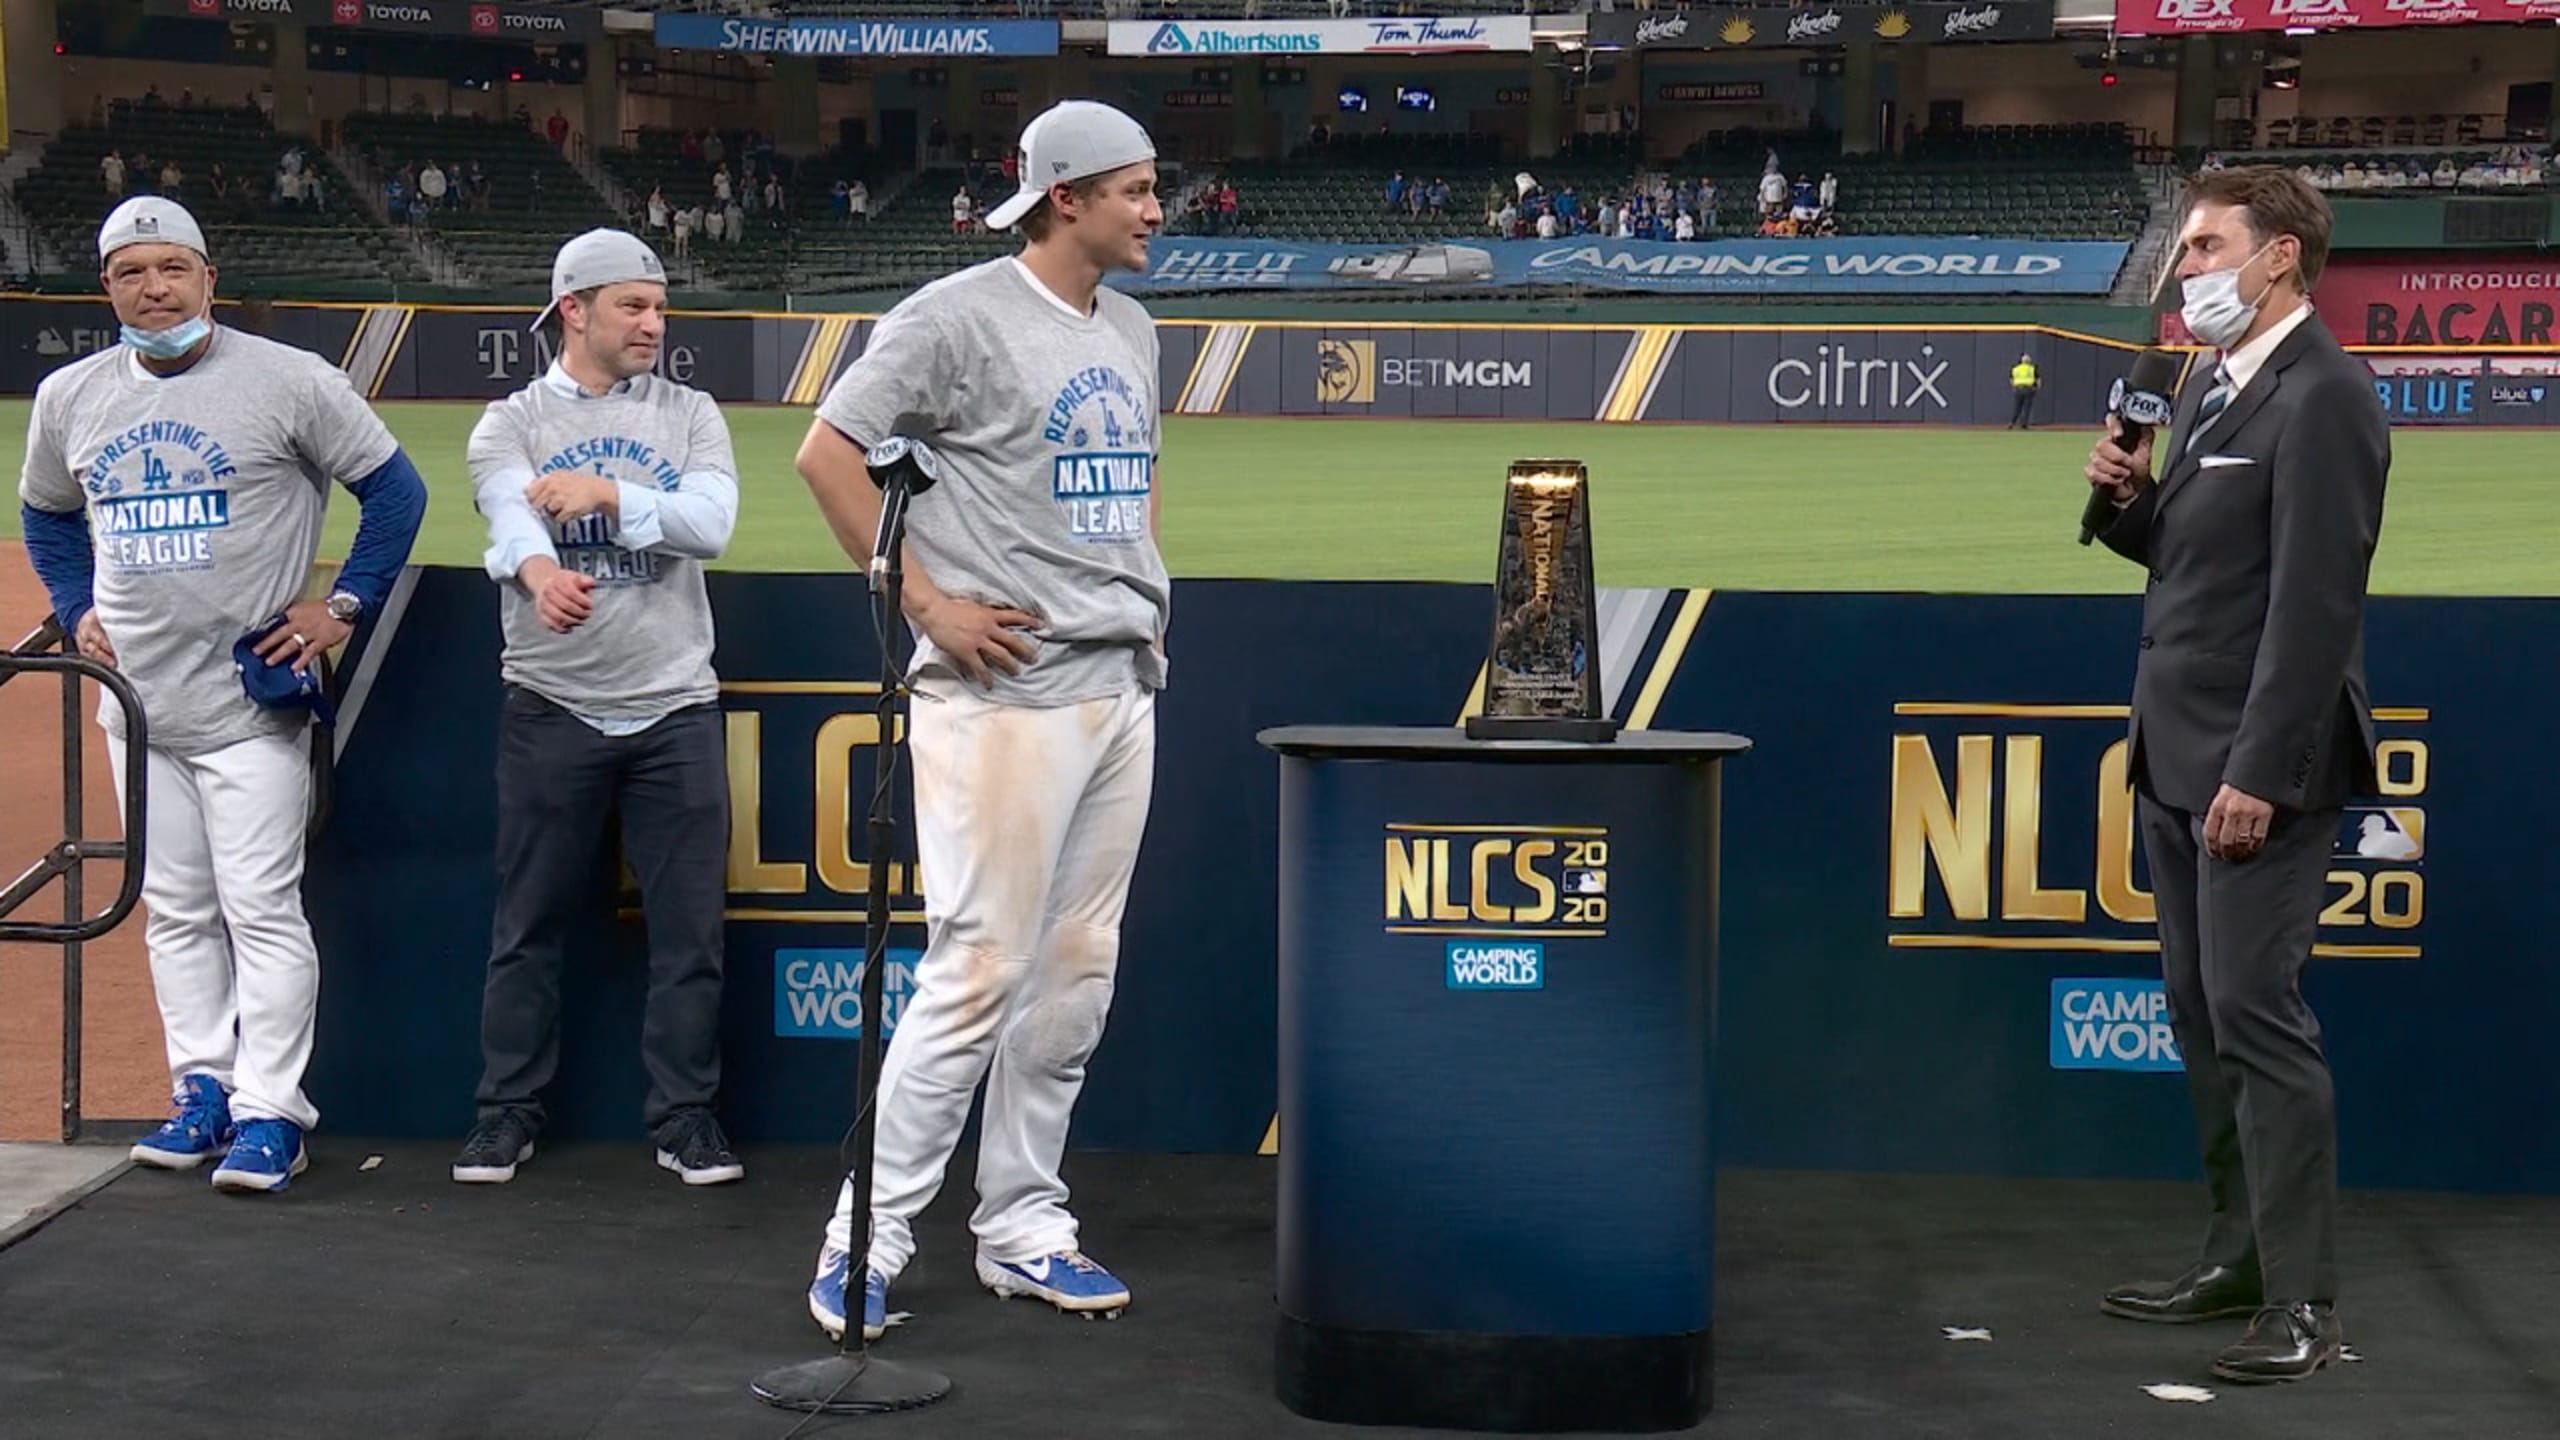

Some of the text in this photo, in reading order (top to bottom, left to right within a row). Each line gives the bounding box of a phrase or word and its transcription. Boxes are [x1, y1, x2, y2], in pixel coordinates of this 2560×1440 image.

[367, 4, 432, 21] TOYOTA
[502, 15, 566, 31] TOYOTA
[1194, 30, 1320, 52] Albertsons
[1367, 18, 1486, 44] Tom Thumb
[1159, 249, 1251, 268] HIT
[1531, 246, 2062, 276] CAMPING WORLD
[1382, 358, 1532, 387] BETMGM
[1767, 345, 1950, 408] citrix
[2131, 396, 2158, 415] FOX
[87, 420, 237, 495] REPRESENTING THE
[141, 448, 173, 491] LA
[100, 494, 226, 535] NATIONAL
[2375, 739, 2429, 796] 0
[1888, 734, 2158, 923] NLC
[1563, 841, 1608, 867] 20
[1385, 837, 1556, 923] NLCS
[1562, 897, 1608, 923] 20
[2318, 870, 2424, 928] 20
[1451, 948, 1537, 966] CAMPING
[785, 960, 919, 992] CAMIN
[1453, 965, 1537, 984] WORLD
[2062, 989, 2167, 1021] CAMP
[2063, 1021, 2183, 1061] WOR
